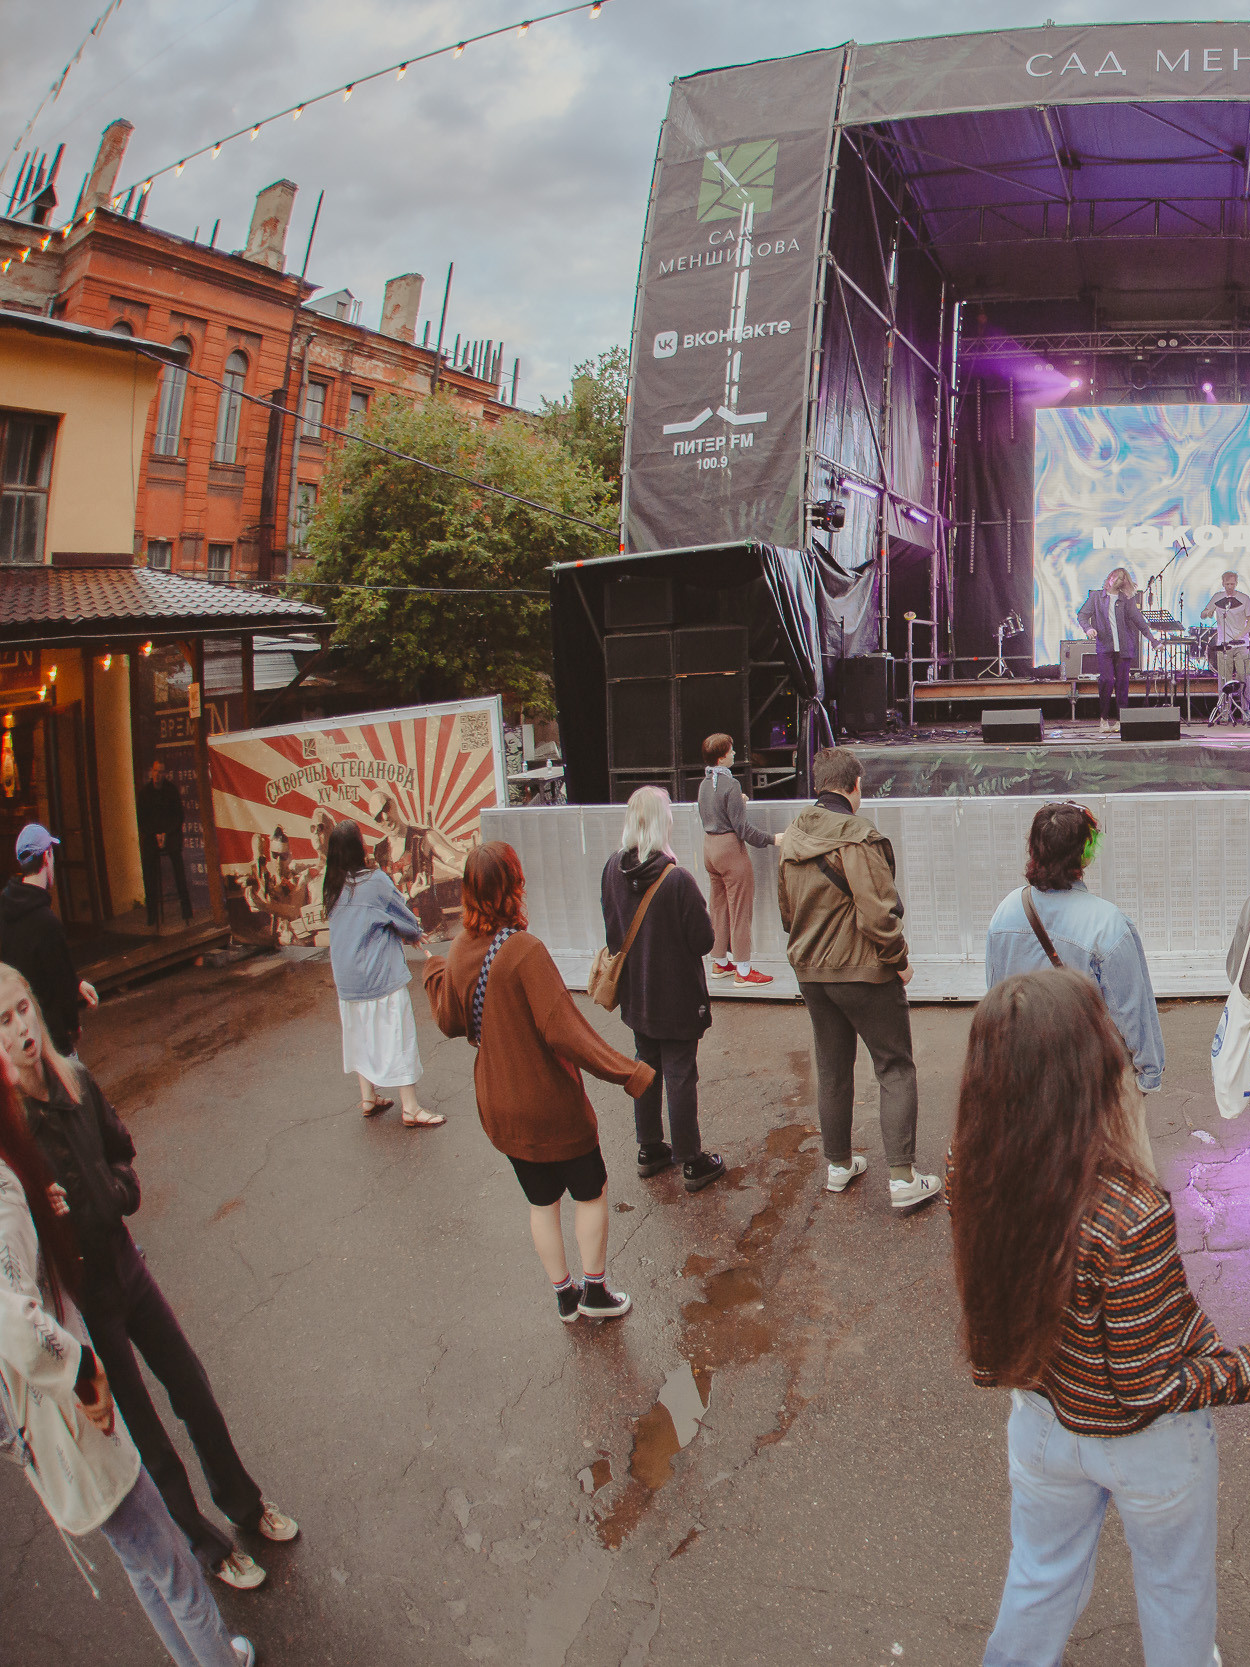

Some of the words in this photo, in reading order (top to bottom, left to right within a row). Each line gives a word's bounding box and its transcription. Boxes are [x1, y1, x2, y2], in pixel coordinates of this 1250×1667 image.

[1025, 50, 1127, 77] САД
[708, 227, 752, 245] САД
[730, 432, 754, 449] FM
[696, 456, 729, 470] 100.9
[159, 716, 197, 739] ВРЕМ
[266, 763, 326, 803] СКВОРЦЫ
[331, 760, 416, 791] СТЕПАНОВА
[338, 784, 361, 801] ЛЕТ
